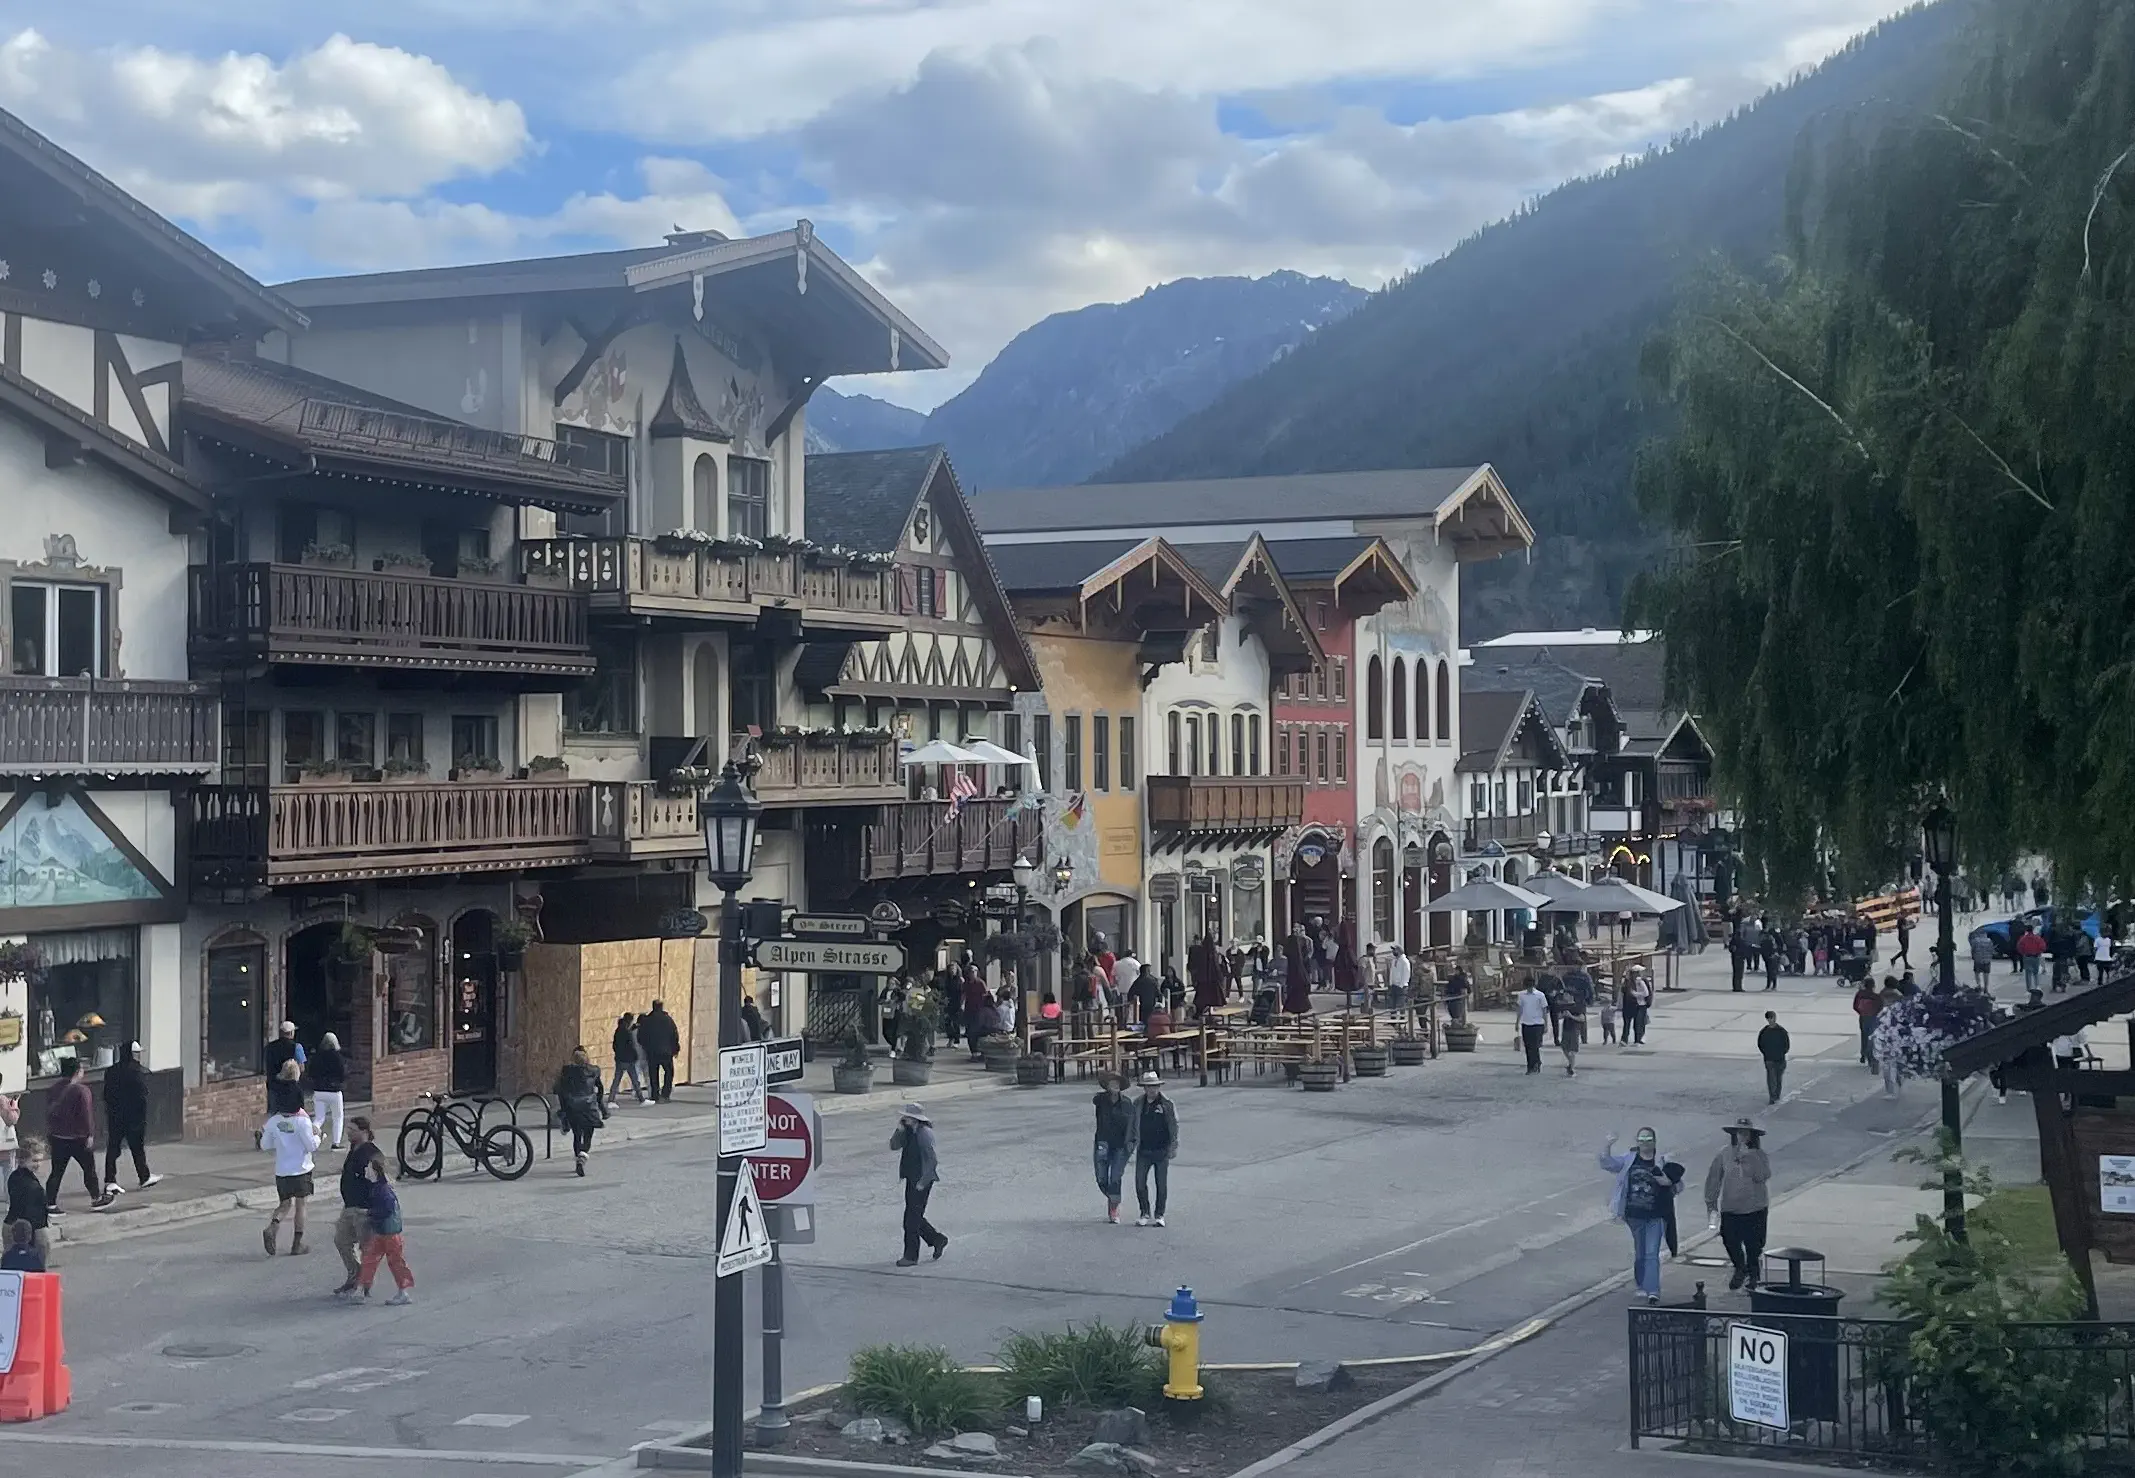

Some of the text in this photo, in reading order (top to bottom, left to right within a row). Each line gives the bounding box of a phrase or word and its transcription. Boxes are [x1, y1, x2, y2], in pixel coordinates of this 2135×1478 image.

[820, 920, 858, 930] Street
[770, 945, 888, 966] Alpen Strasse
[782, 1052, 799, 1069] WAY
[729, 1066, 756, 1077] PARKING
[721, 1077, 763, 1091] REGULATIONS
[767, 1114, 798, 1131] NOT
[749, 1163, 791, 1180] NTER
[1740, 1336, 1775, 1364] NO
